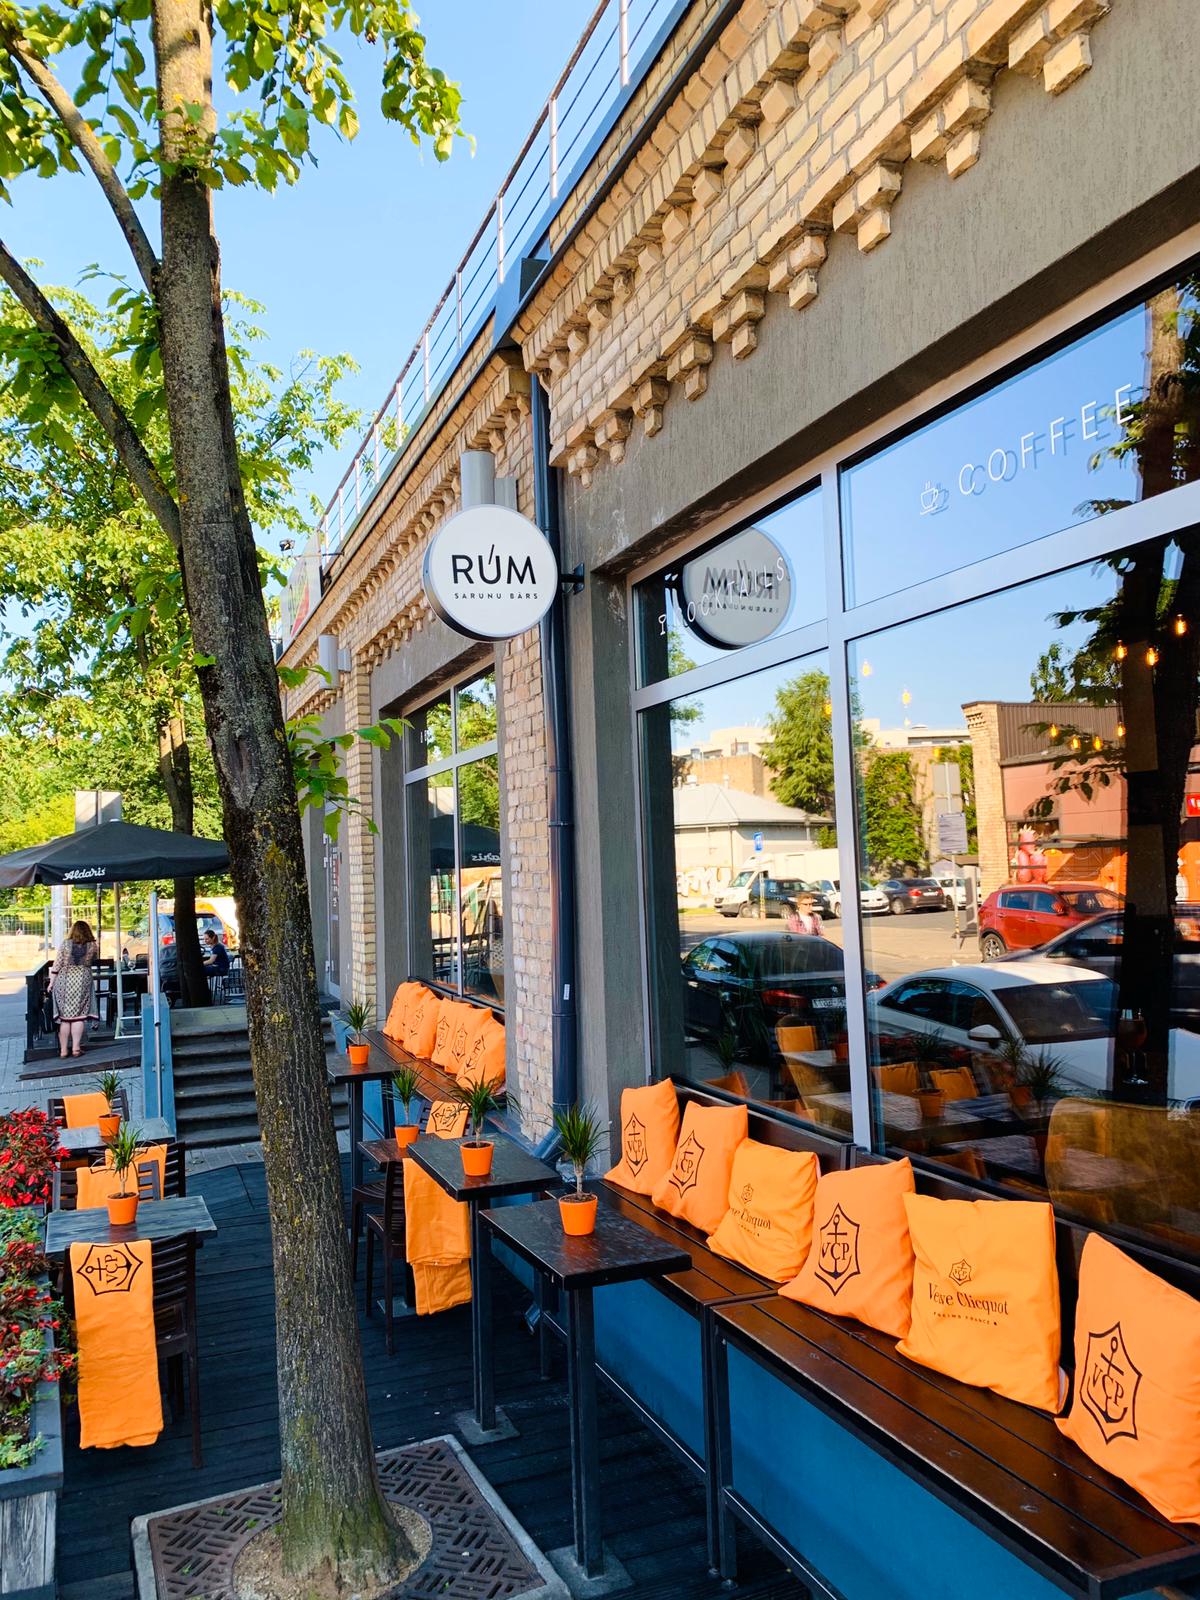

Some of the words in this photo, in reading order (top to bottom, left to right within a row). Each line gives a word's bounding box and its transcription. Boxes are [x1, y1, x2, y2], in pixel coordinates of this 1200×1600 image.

[958, 383, 1135, 495] COFFEE
[454, 592, 502, 600] SARUNU
[675, 556, 785, 627] OCKTAILS
[62, 866, 106, 881] Aldaris
[821, 1241, 850, 1261] VCP
[105, 1253, 118, 1285] VCP
[956, 1291, 1009, 1316] Clicquot
[1092, 1362, 1125, 1407] VCP
